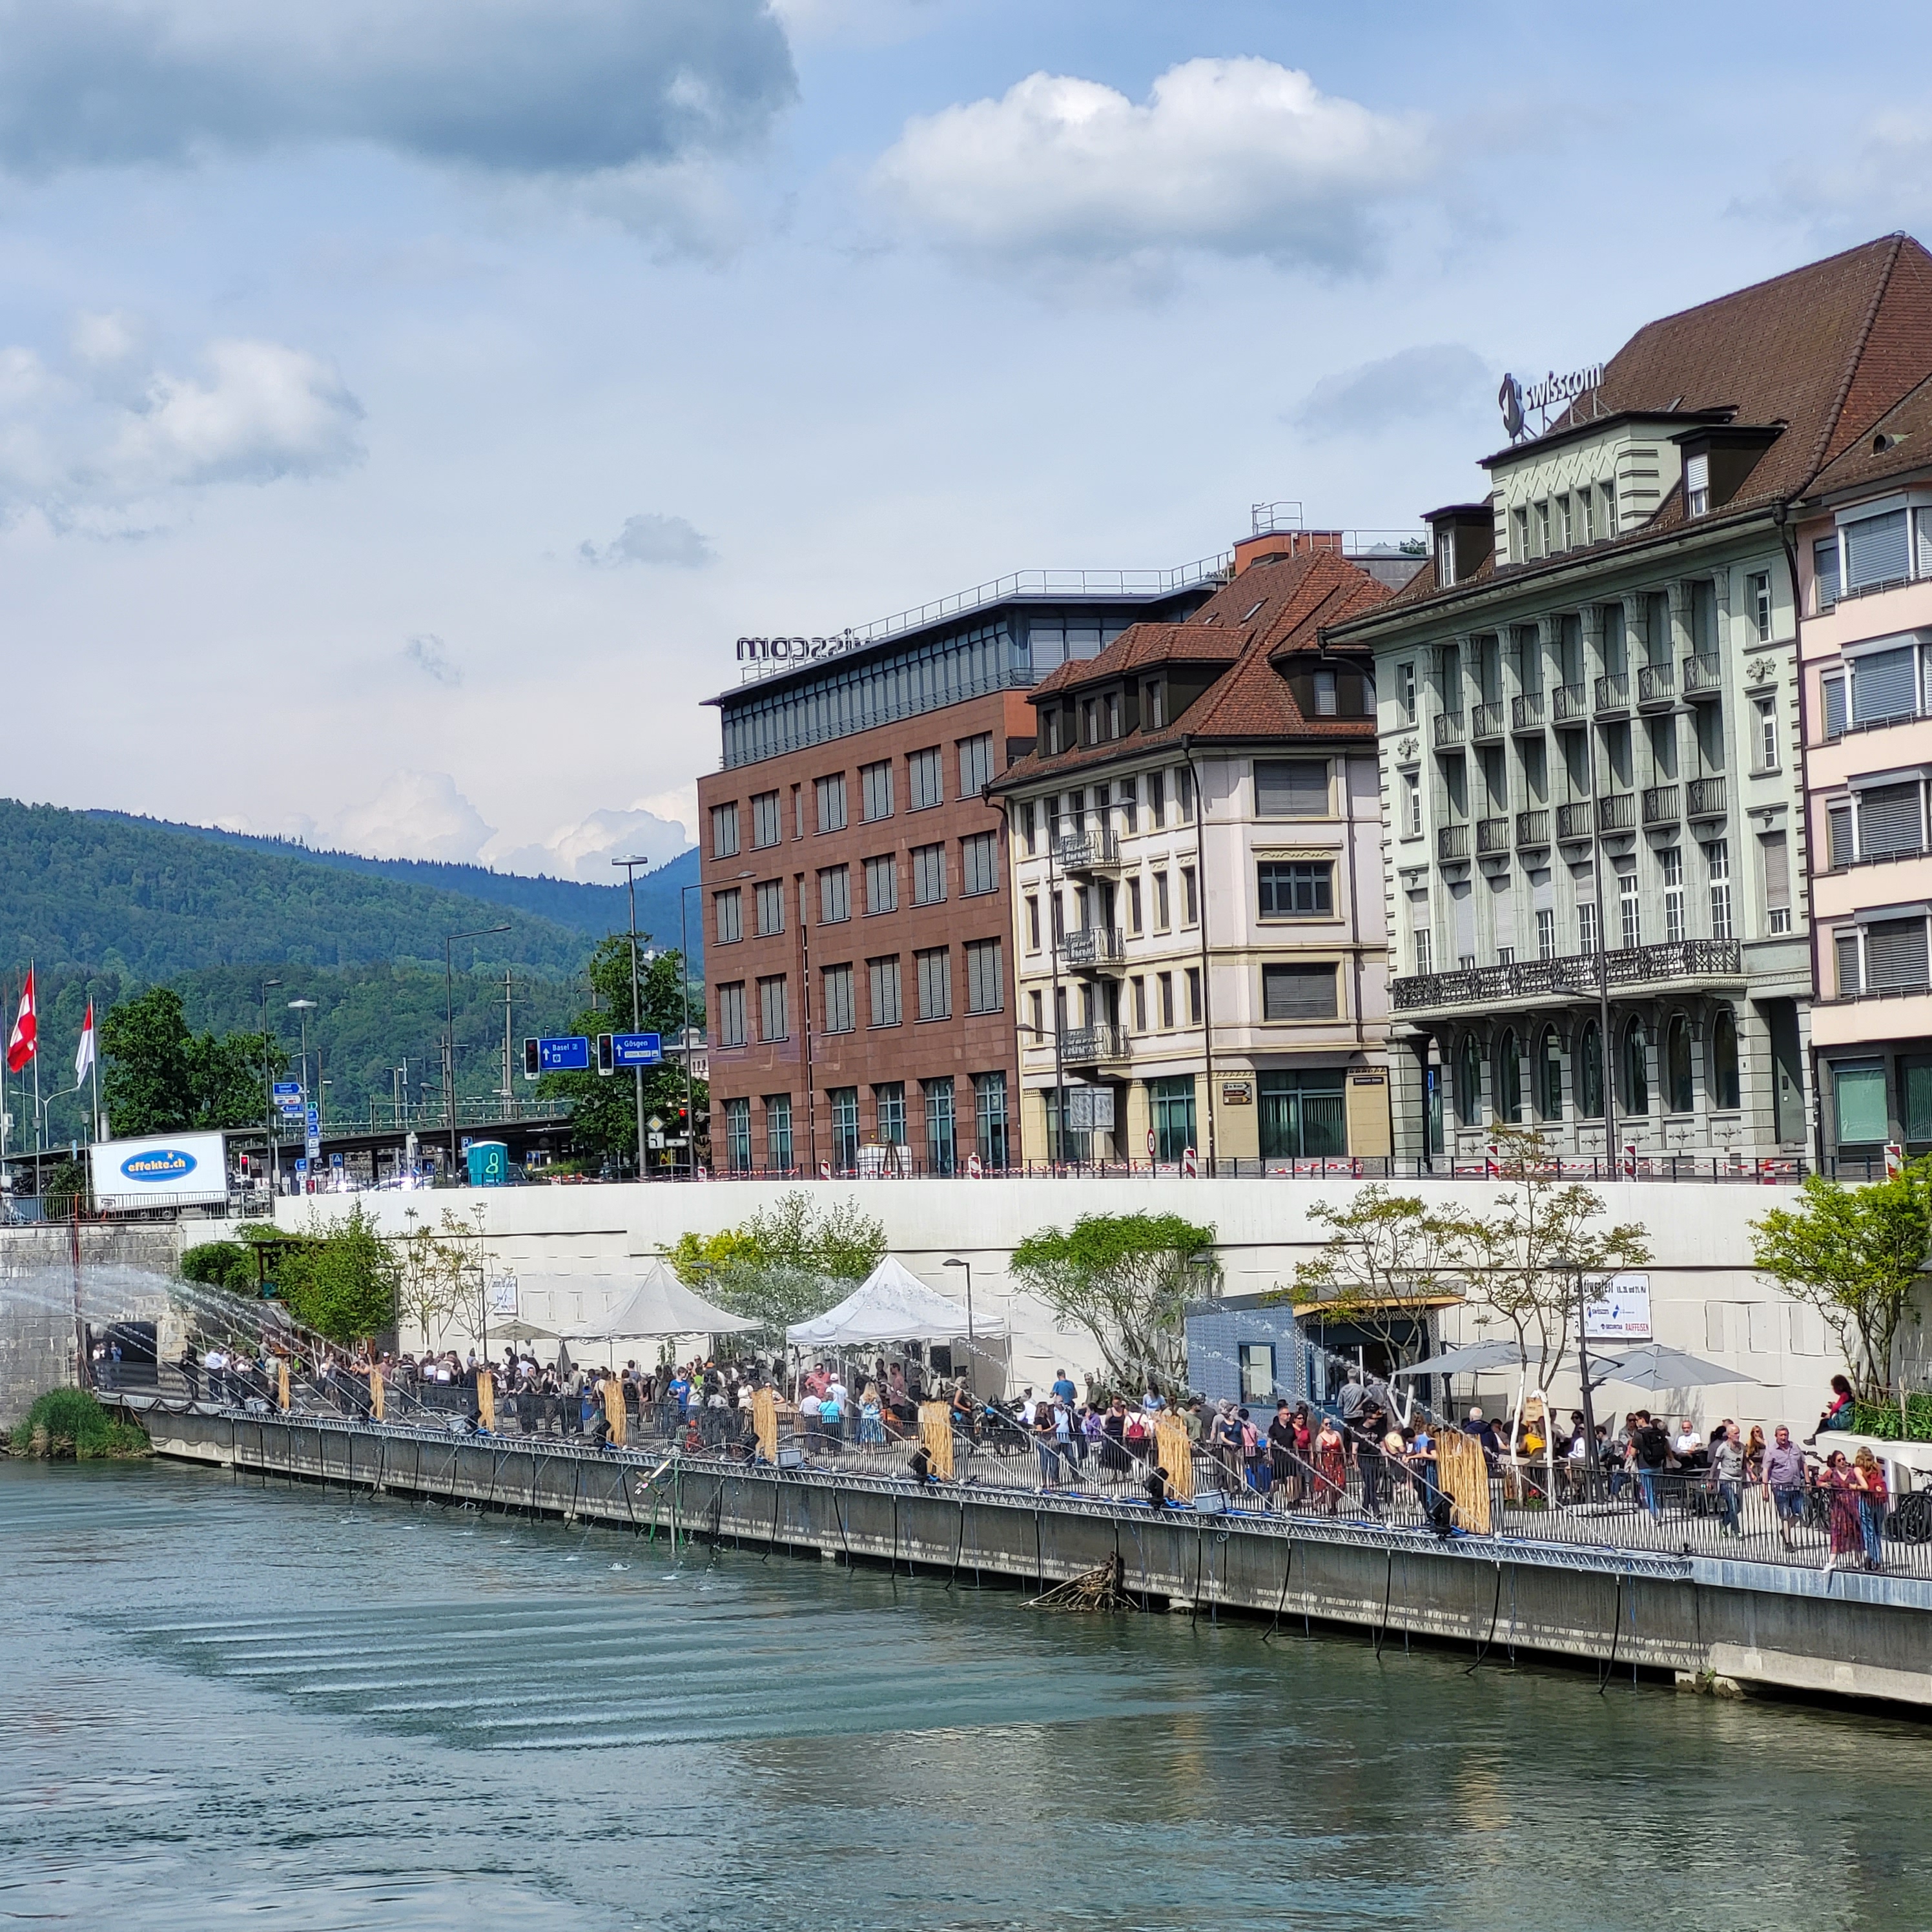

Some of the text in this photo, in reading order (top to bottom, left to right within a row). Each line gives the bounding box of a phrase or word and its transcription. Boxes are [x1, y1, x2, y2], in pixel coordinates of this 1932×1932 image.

[1525, 363, 1605, 411] swisscom
[552, 1043, 570, 1051] Basel
[624, 1040, 648, 1049] Gösgen
[128, 1158, 186, 1172] effekte.ch
[1573, 1279, 1614, 1293] Ldiwefest
